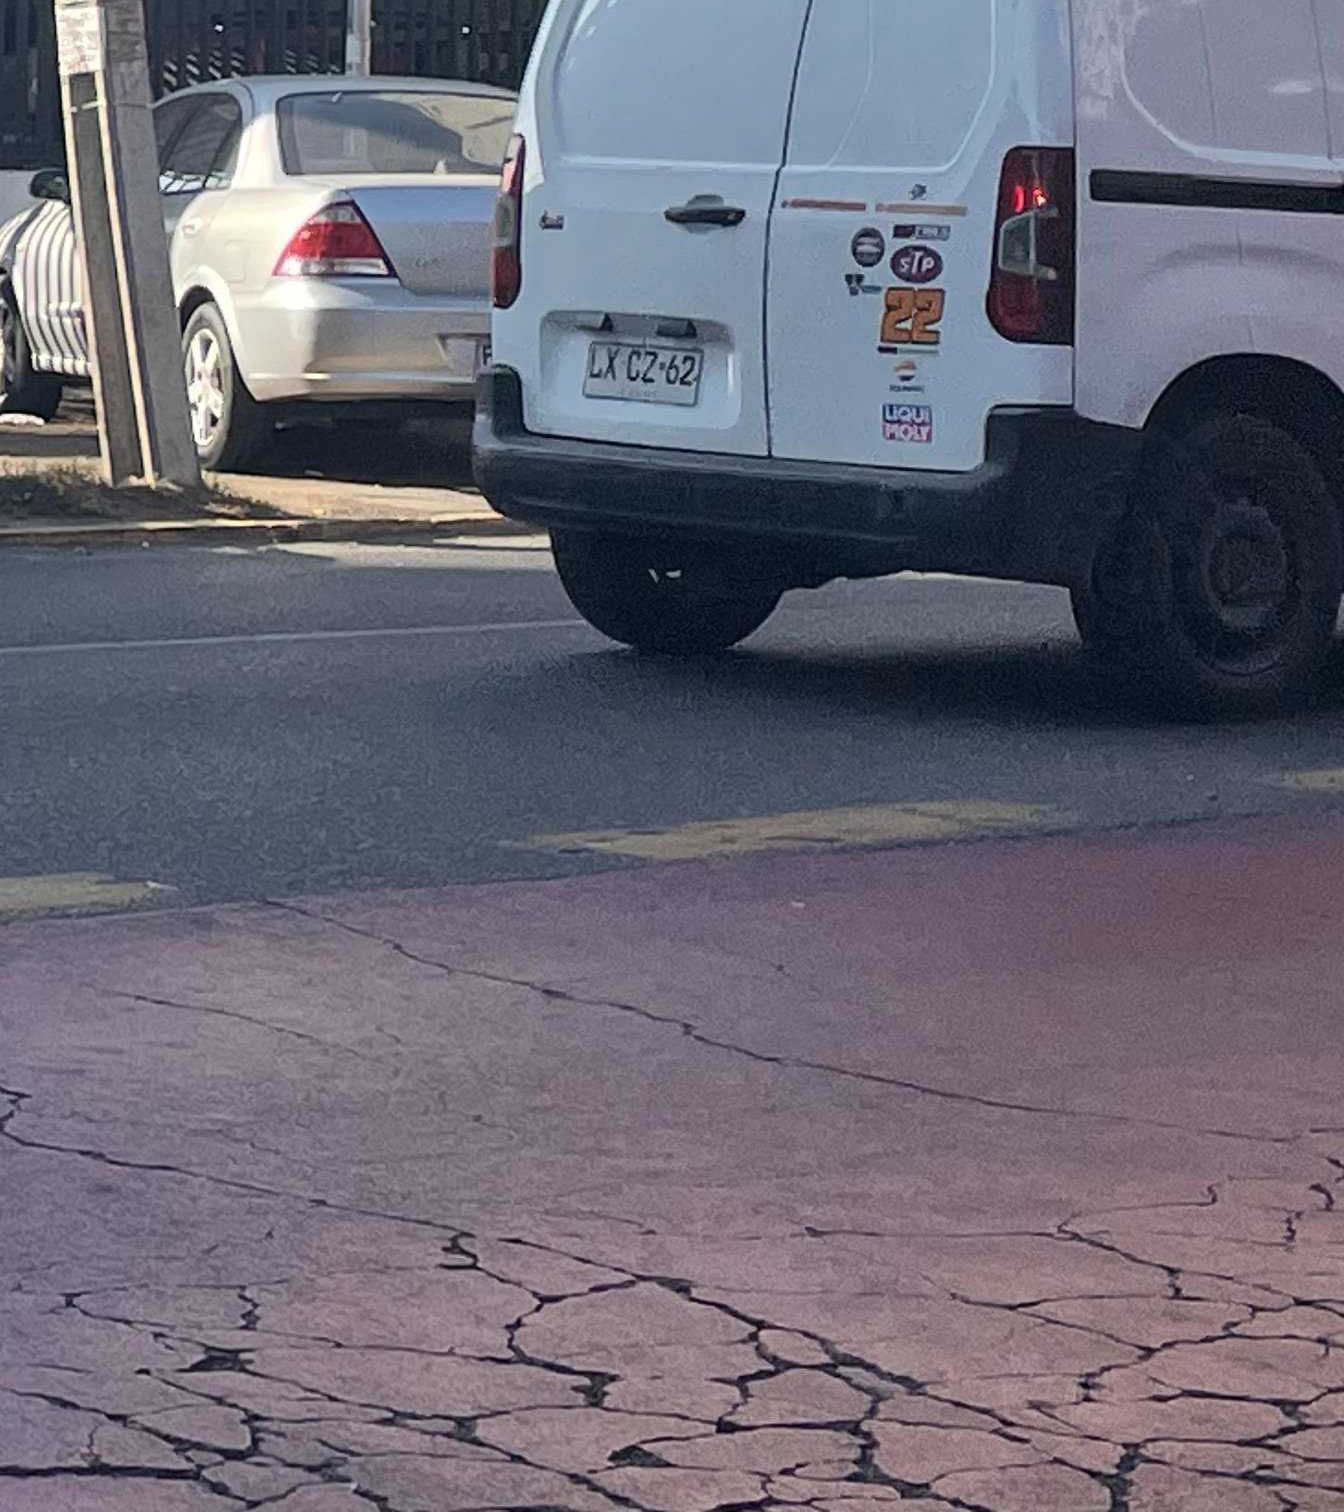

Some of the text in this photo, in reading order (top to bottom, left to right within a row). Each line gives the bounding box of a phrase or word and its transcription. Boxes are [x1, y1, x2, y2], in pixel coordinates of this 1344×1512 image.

[899, 251, 935, 275] STP
[880, 286, 945, 345] 22
[885, 404, 931, 424] LIQUI
[885, 423, 932, 442] MOLY
